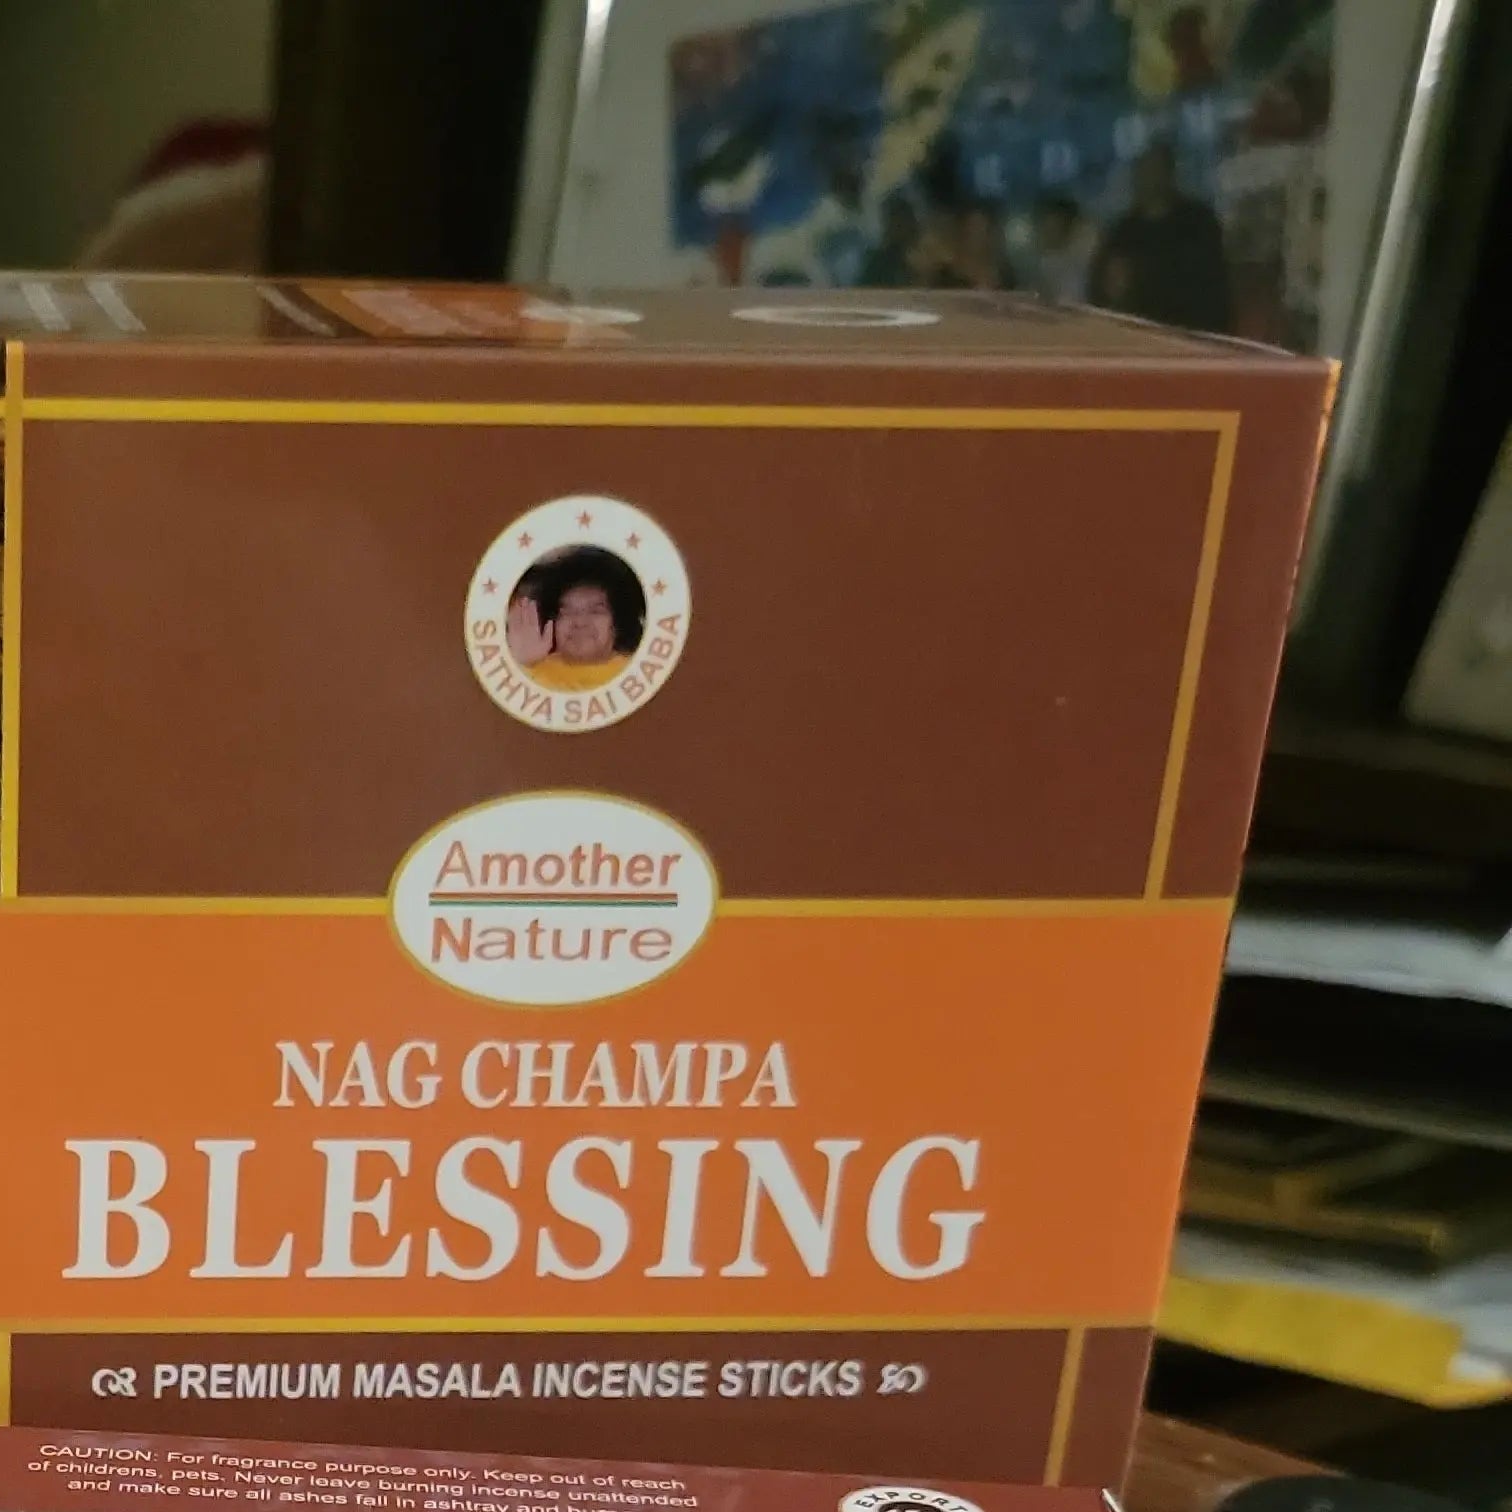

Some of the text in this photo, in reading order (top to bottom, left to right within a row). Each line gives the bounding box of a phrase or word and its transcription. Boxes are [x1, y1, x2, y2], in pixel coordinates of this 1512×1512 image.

[473, 613, 682, 724] SATHYA SAI BABA
[434, 840, 681, 888] Amother
[431, 917, 673, 963] Nature
[273, 1041, 798, 1109] NAG CHAMPA
[61, 1135, 986, 1282] BLESSING
[153, 1361, 863, 1399] PREMIUM MASALA INCENSE STICKS
[28, 1459, 49, 1473] of
[234, 1470, 302, 1486] Never
[309, 1474, 370, 1489] leave
[377, 1478, 464, 1497] burning
[472, 1483, 560, 1499] incense
[568, 1489, 698, 1508] unattended
[39, 1444, 686, 1491] CAUTION: For fragrance purpose only. Keep out of reach
[67, 1479, 111, 1492] and
[119, 1481, 181, 1496] make
[188, 1487, 238, 1500] sure
[245, 1488, 270, 1502] all
[279, 1491, 348, 1506] ashes
[356, 1493, 388, 1508] fall
[396, 1494, 416, 1509] in
[854, 1491, 969, 1512] EXPORT
